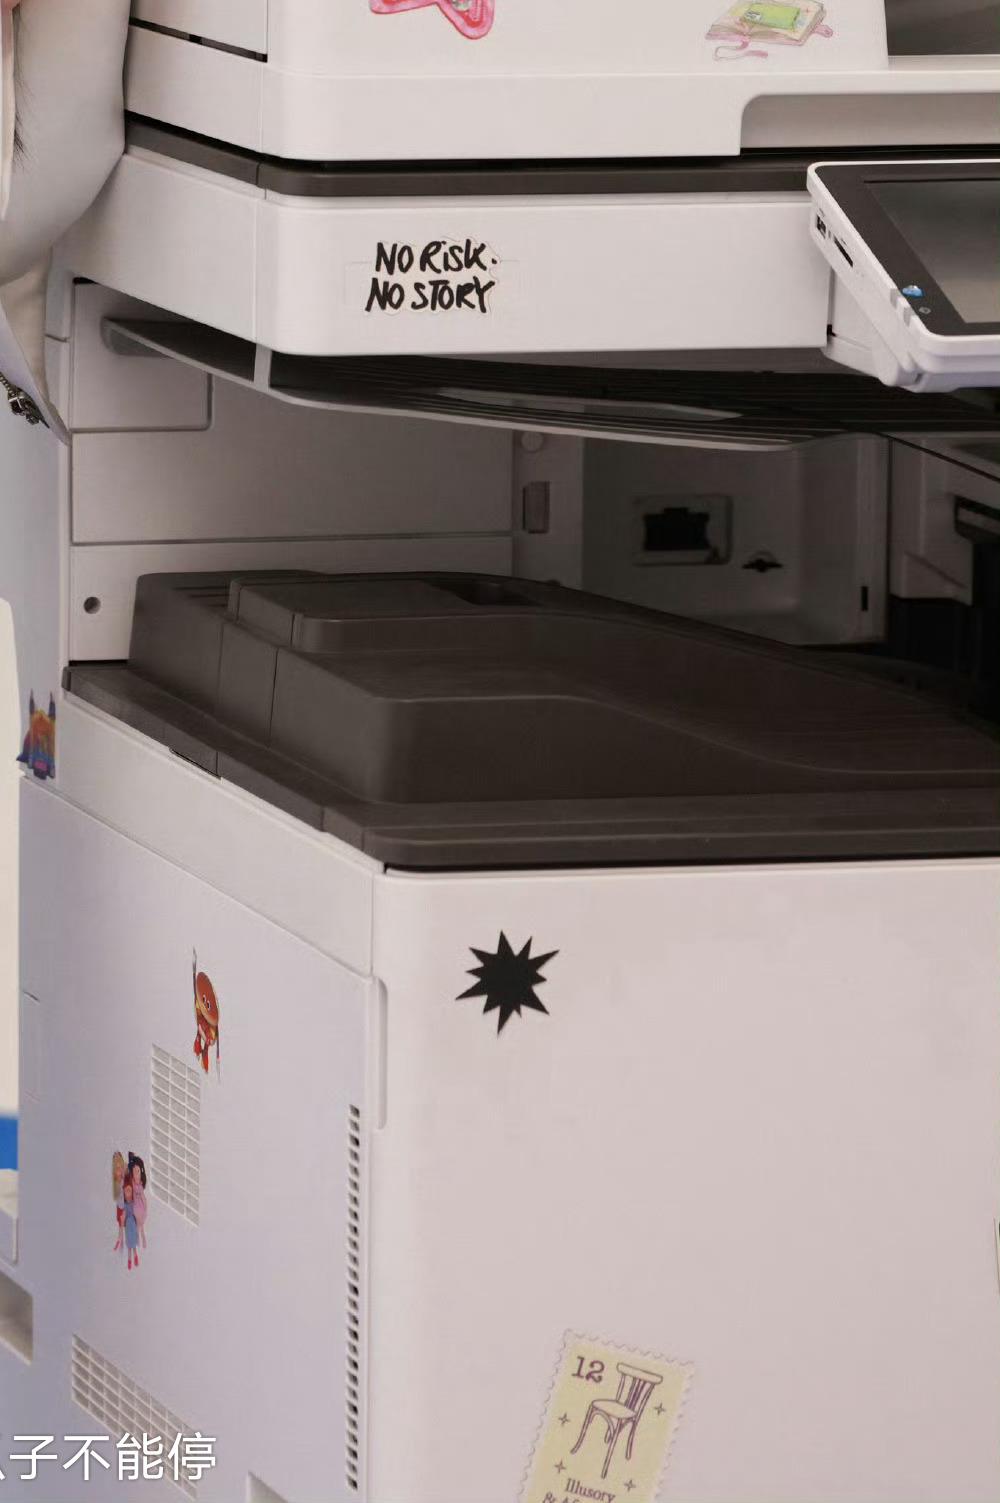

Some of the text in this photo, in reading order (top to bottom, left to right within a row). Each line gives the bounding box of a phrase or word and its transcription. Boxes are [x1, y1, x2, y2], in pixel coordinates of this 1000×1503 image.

[375, 242, 414, 275] NO
[365, 276, 495, 313] NO STORY
[571, 1356, 605, 1383] 12
[565, 1478, 616, 1503] Illusory
